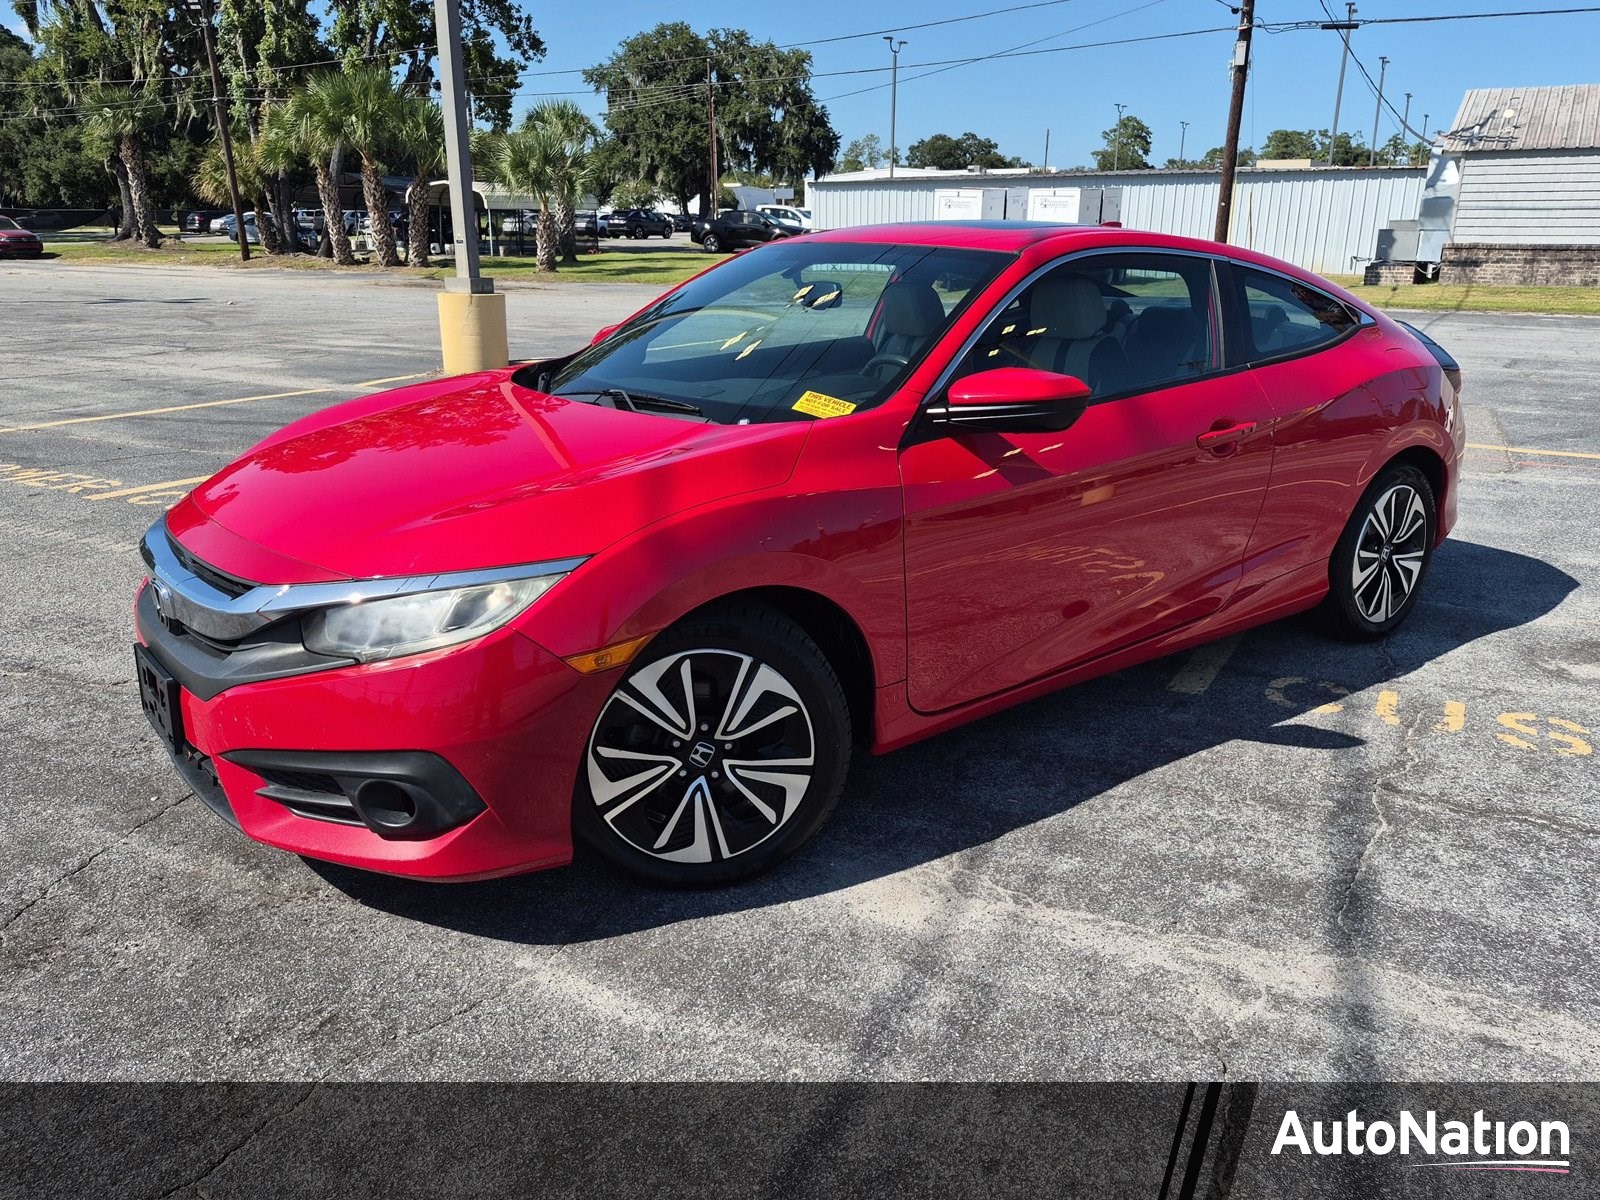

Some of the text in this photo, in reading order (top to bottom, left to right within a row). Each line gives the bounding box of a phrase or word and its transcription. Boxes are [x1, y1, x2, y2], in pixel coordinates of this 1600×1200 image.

[807, 392, 824, 401] THIS
[823, 396, 853, 410] VEHICLE
[830, 405, 847, 414] SALE
